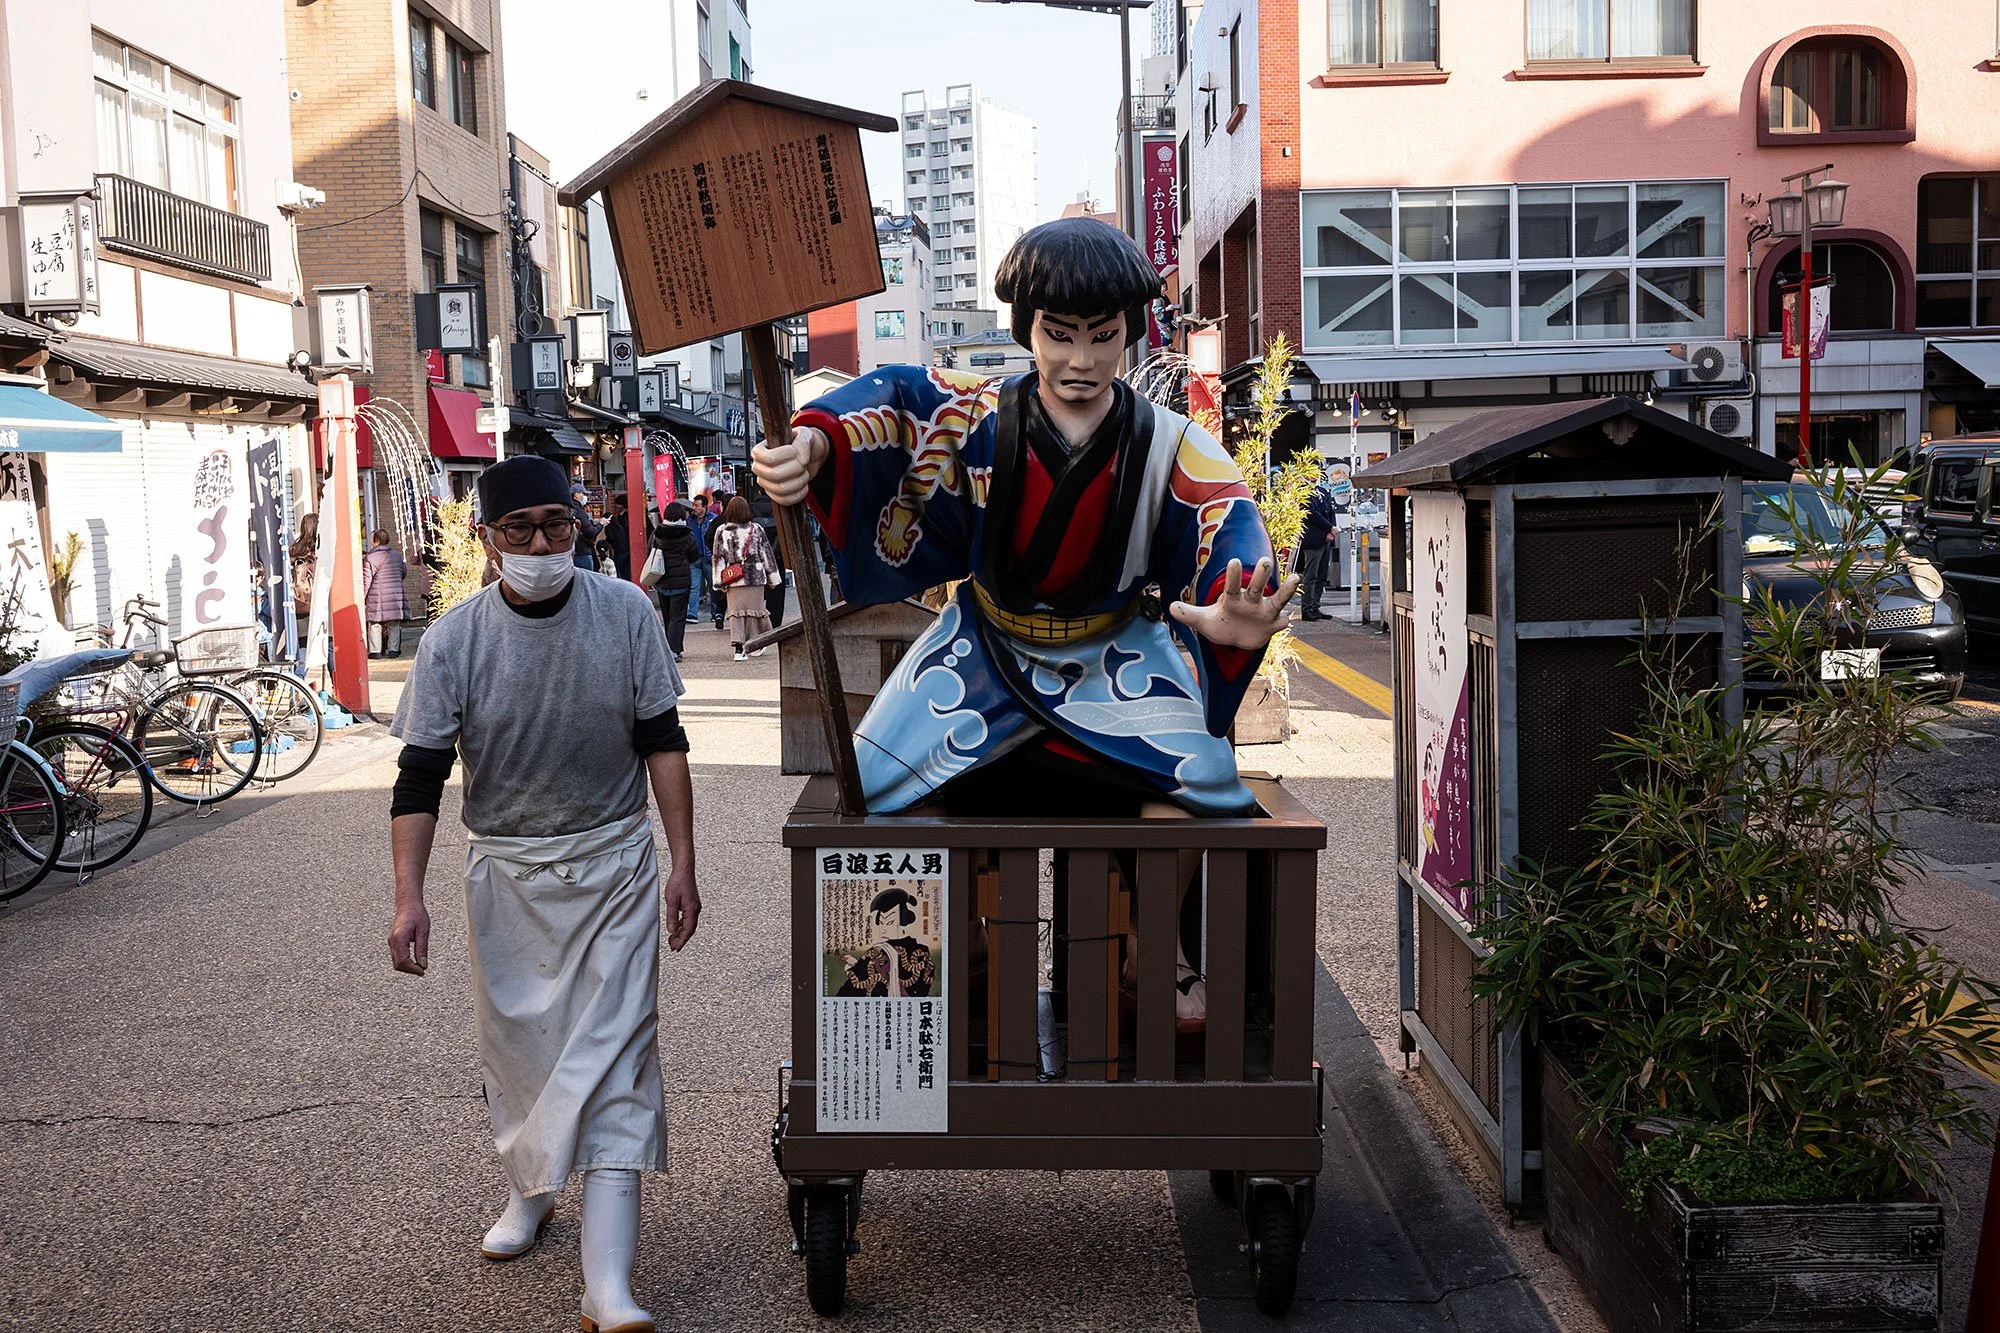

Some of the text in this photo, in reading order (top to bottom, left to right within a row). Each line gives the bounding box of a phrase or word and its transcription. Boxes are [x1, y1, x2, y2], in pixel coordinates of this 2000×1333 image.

[692, 164, 718, 230] 河竹黙阿弥
[1152, 186, 1167, 265] ふわとろ食感
[48, 232, 64, 272] 豆腐
[62, 208, 75, 250] 手作り
[30, 236, 52, 296] 生ゆば
[334, 298, 347, 344] みやま雑貨
[1452, 736, 1461, 850] 夢が息づく
[822, 852, 943, 875] 白浪五人男
[918, 1000, 934, 1090] 日本駄右衛門
